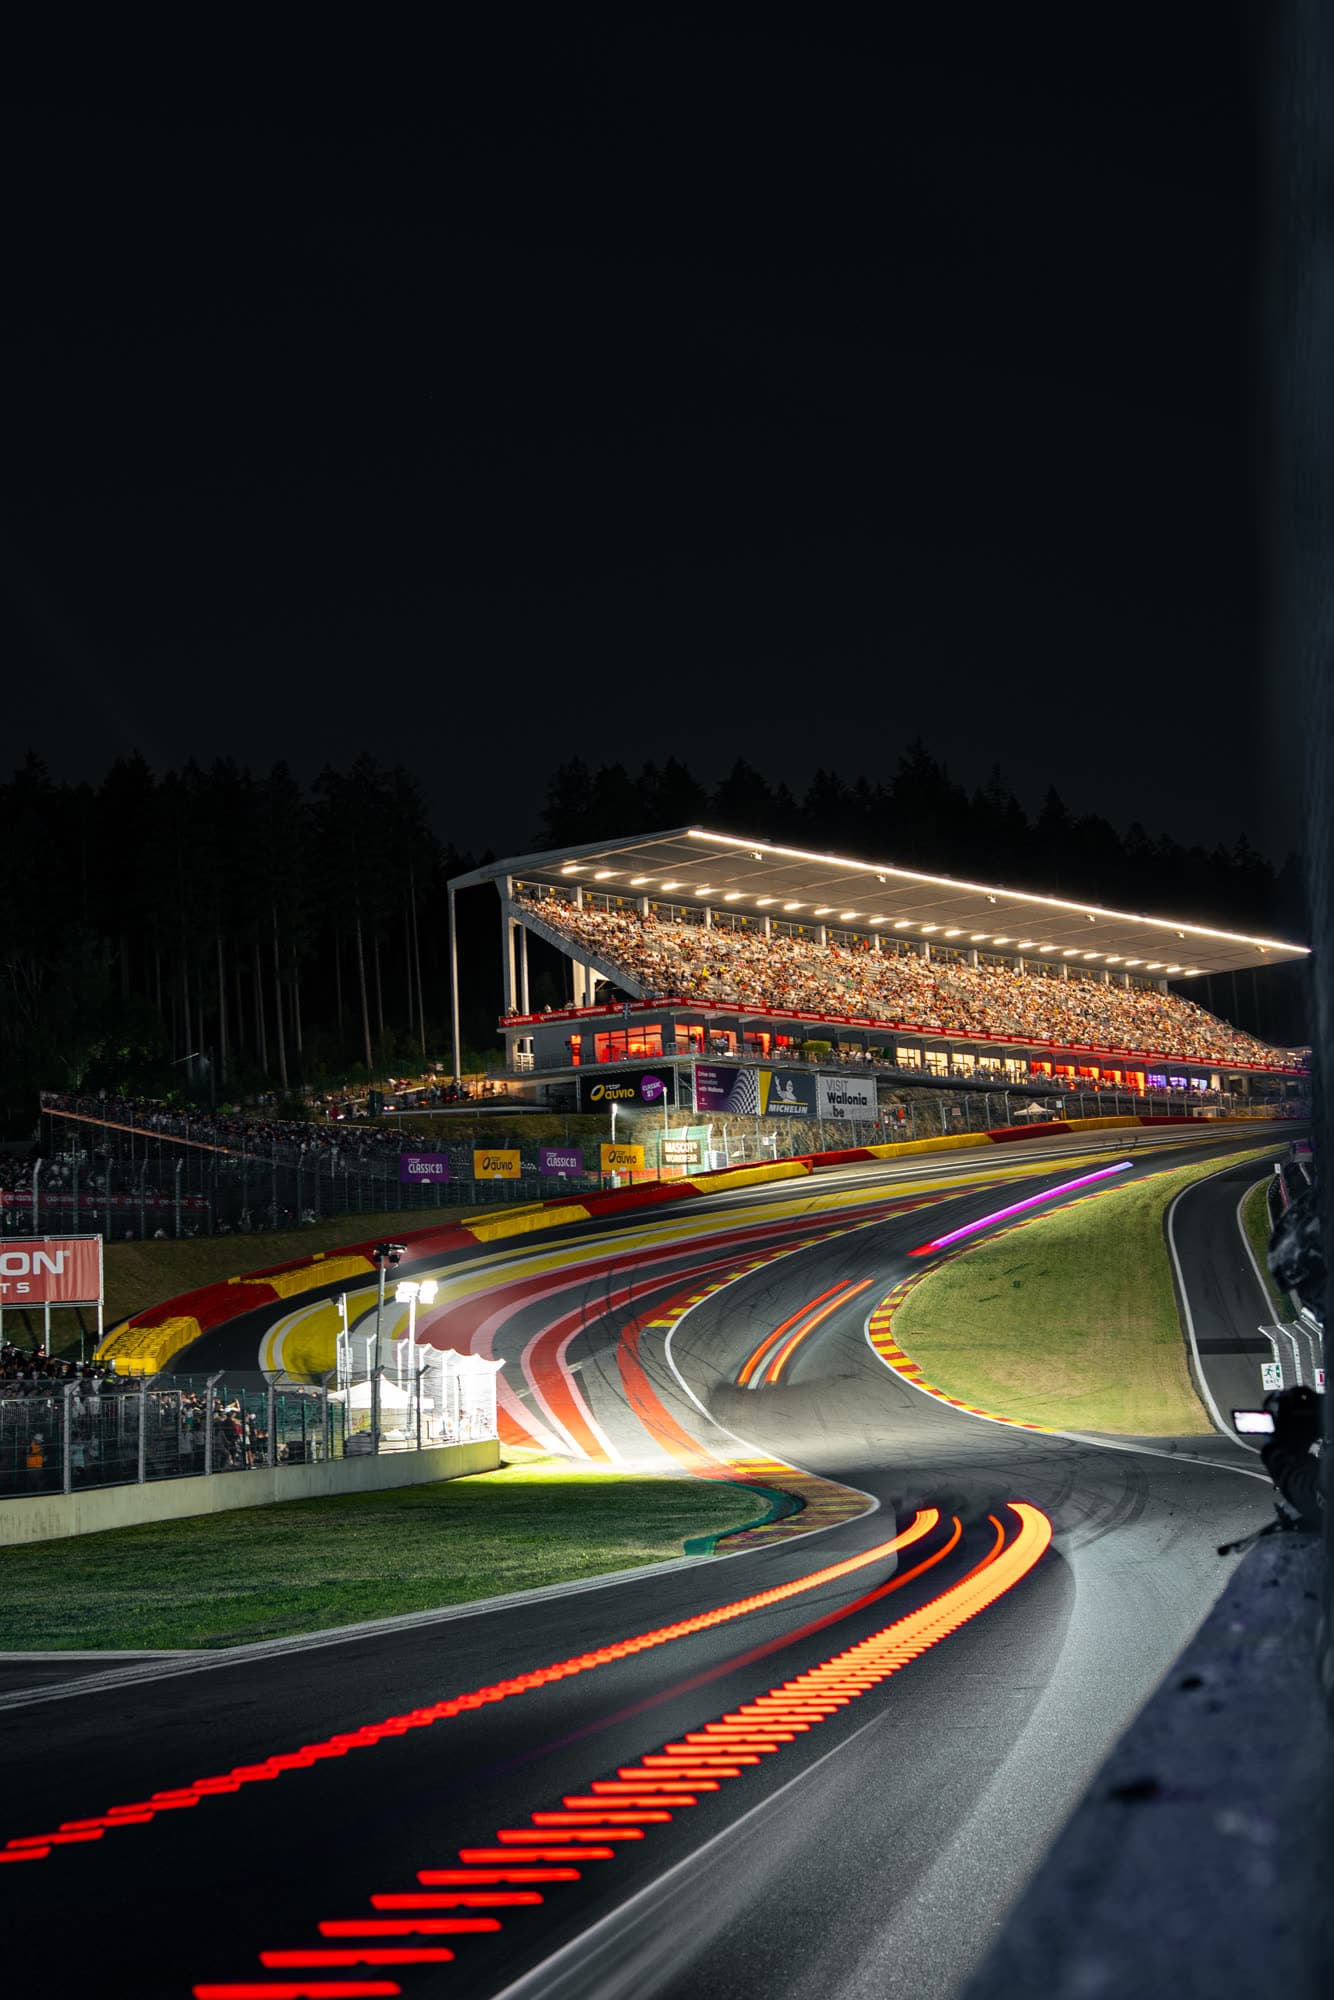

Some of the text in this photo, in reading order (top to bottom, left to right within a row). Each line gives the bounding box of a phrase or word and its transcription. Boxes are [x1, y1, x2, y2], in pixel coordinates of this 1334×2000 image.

[826, 1080, 848, 1091] VISIT
[605, 1088, 635, 1100] auvio
[827, 1092, 867, 1105] Wallonia
[768, 1104, 808, 1114] MICHELIN
[546, 1157, 570, 1167] CLASSIC
[616, 1155, 637, 1164] auvio
[408, 1163, 435, 1174] CLASSIC
[490, 1161, 513, 1170] auvio
[0, 1251, 64, 1276] ON
